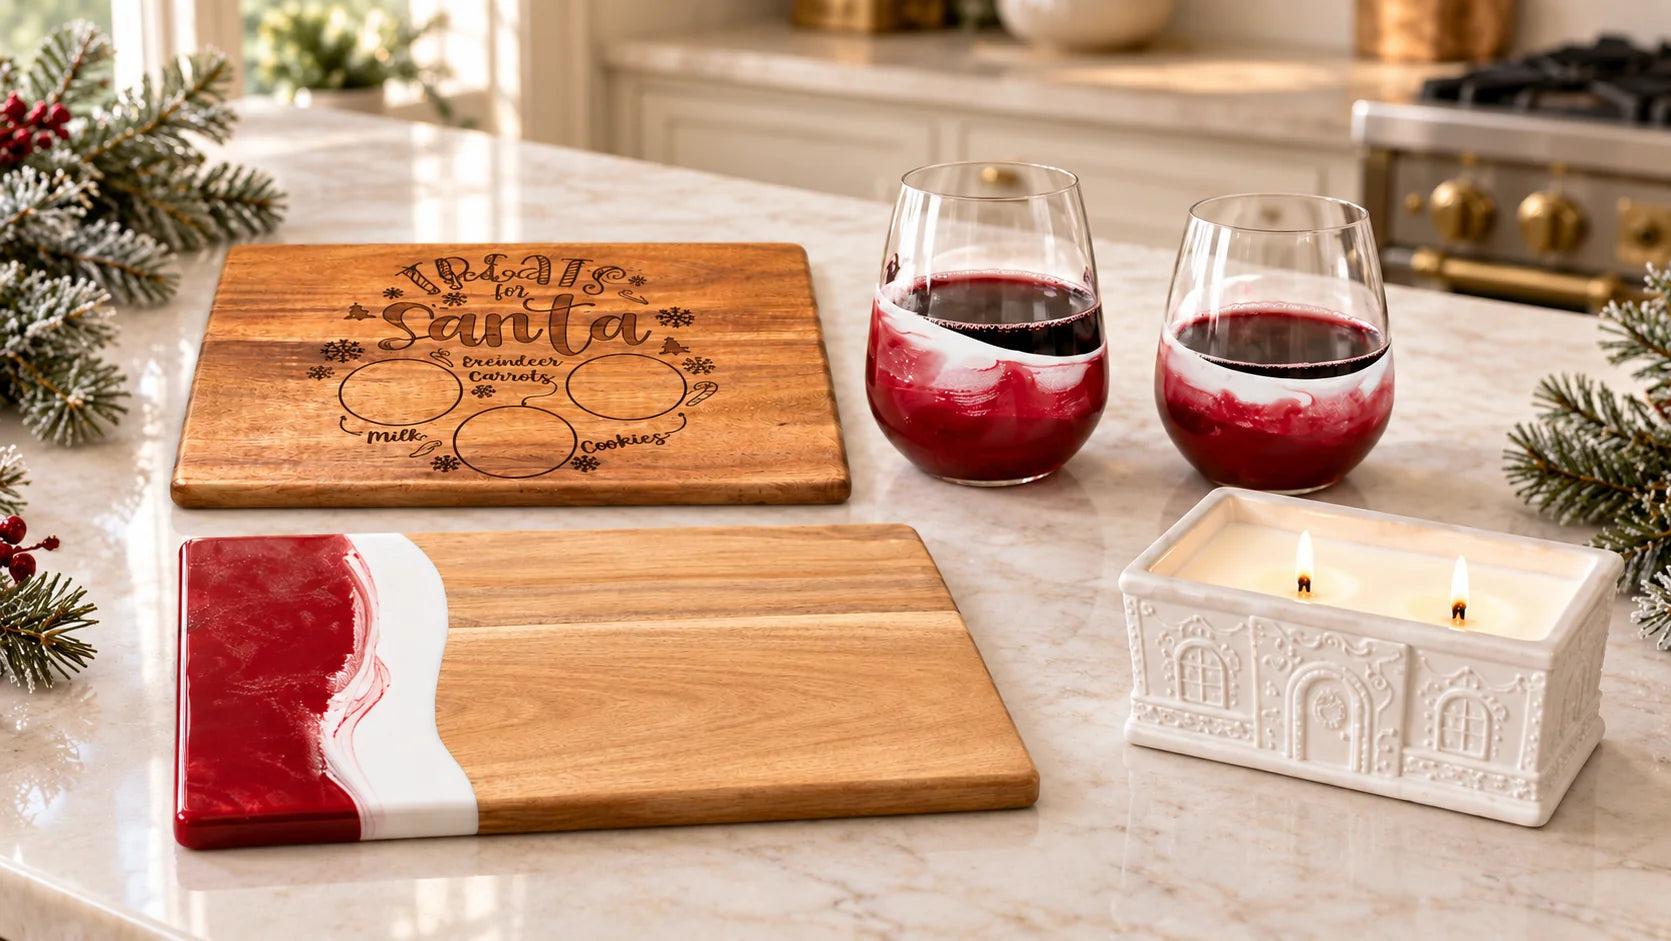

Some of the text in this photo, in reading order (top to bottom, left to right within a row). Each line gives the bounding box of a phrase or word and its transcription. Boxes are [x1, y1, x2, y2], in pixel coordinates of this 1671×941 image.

[495, 283, 528, 300] for
[379, 293, 652, 356] Santa
[468, 370, 554, 384] Carrots
[580, 431, 670, 454] Cookies
